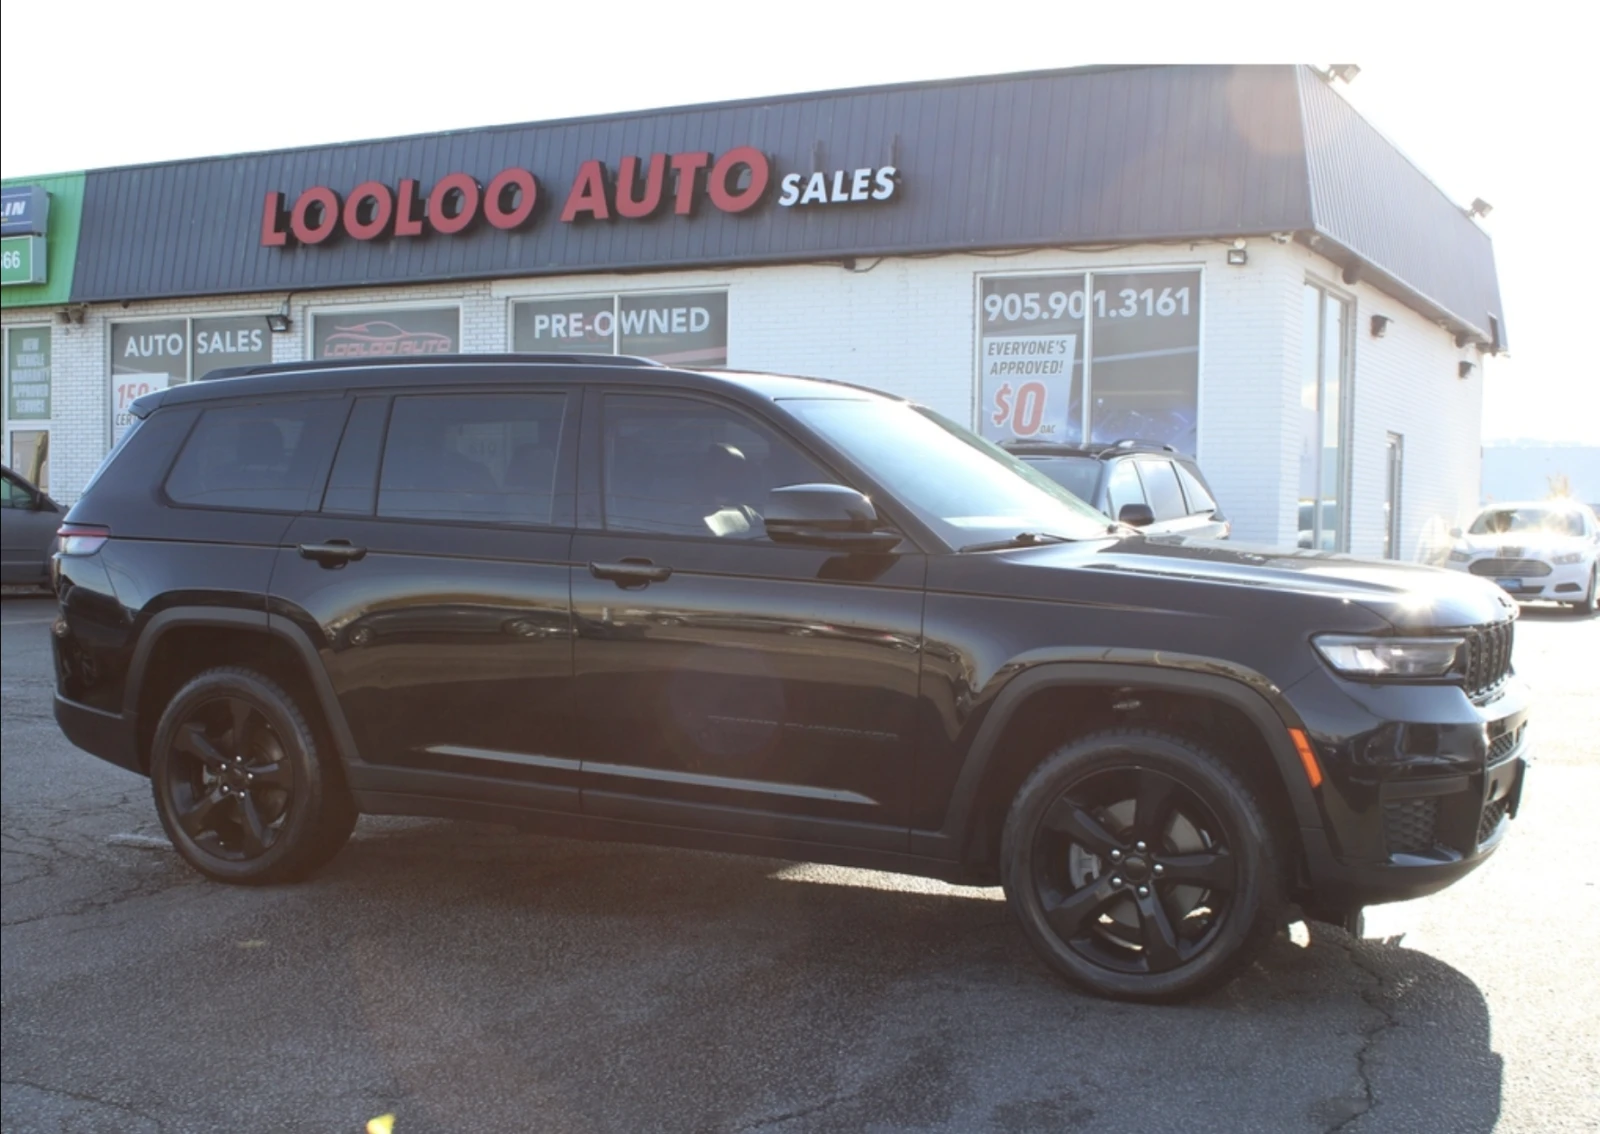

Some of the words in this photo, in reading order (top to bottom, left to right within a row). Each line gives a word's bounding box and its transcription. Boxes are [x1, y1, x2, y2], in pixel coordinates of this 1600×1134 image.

[261, 166, 538, 248] LOOLOO
[560, 146, 769, 222] AUTO
[778, 166, 897, 207] SALES
[1, 251, 21, 269] 66
[984, 287, 1190, 321] 905.901.3161
[534, 307, 710, 339] PRE-OWNED
[124, 333, 184, 358] AUTO
[197, 329, 263, 354] SALES
[324, 341, 396, 357] LOOLOO
[397, 339, 452, 355] AUTO
[988, 340, 1067, 356] EVERYONE'S
[990, 360, 1064, 375] APPROVED!
[993, 381, 1046, 436] $0
